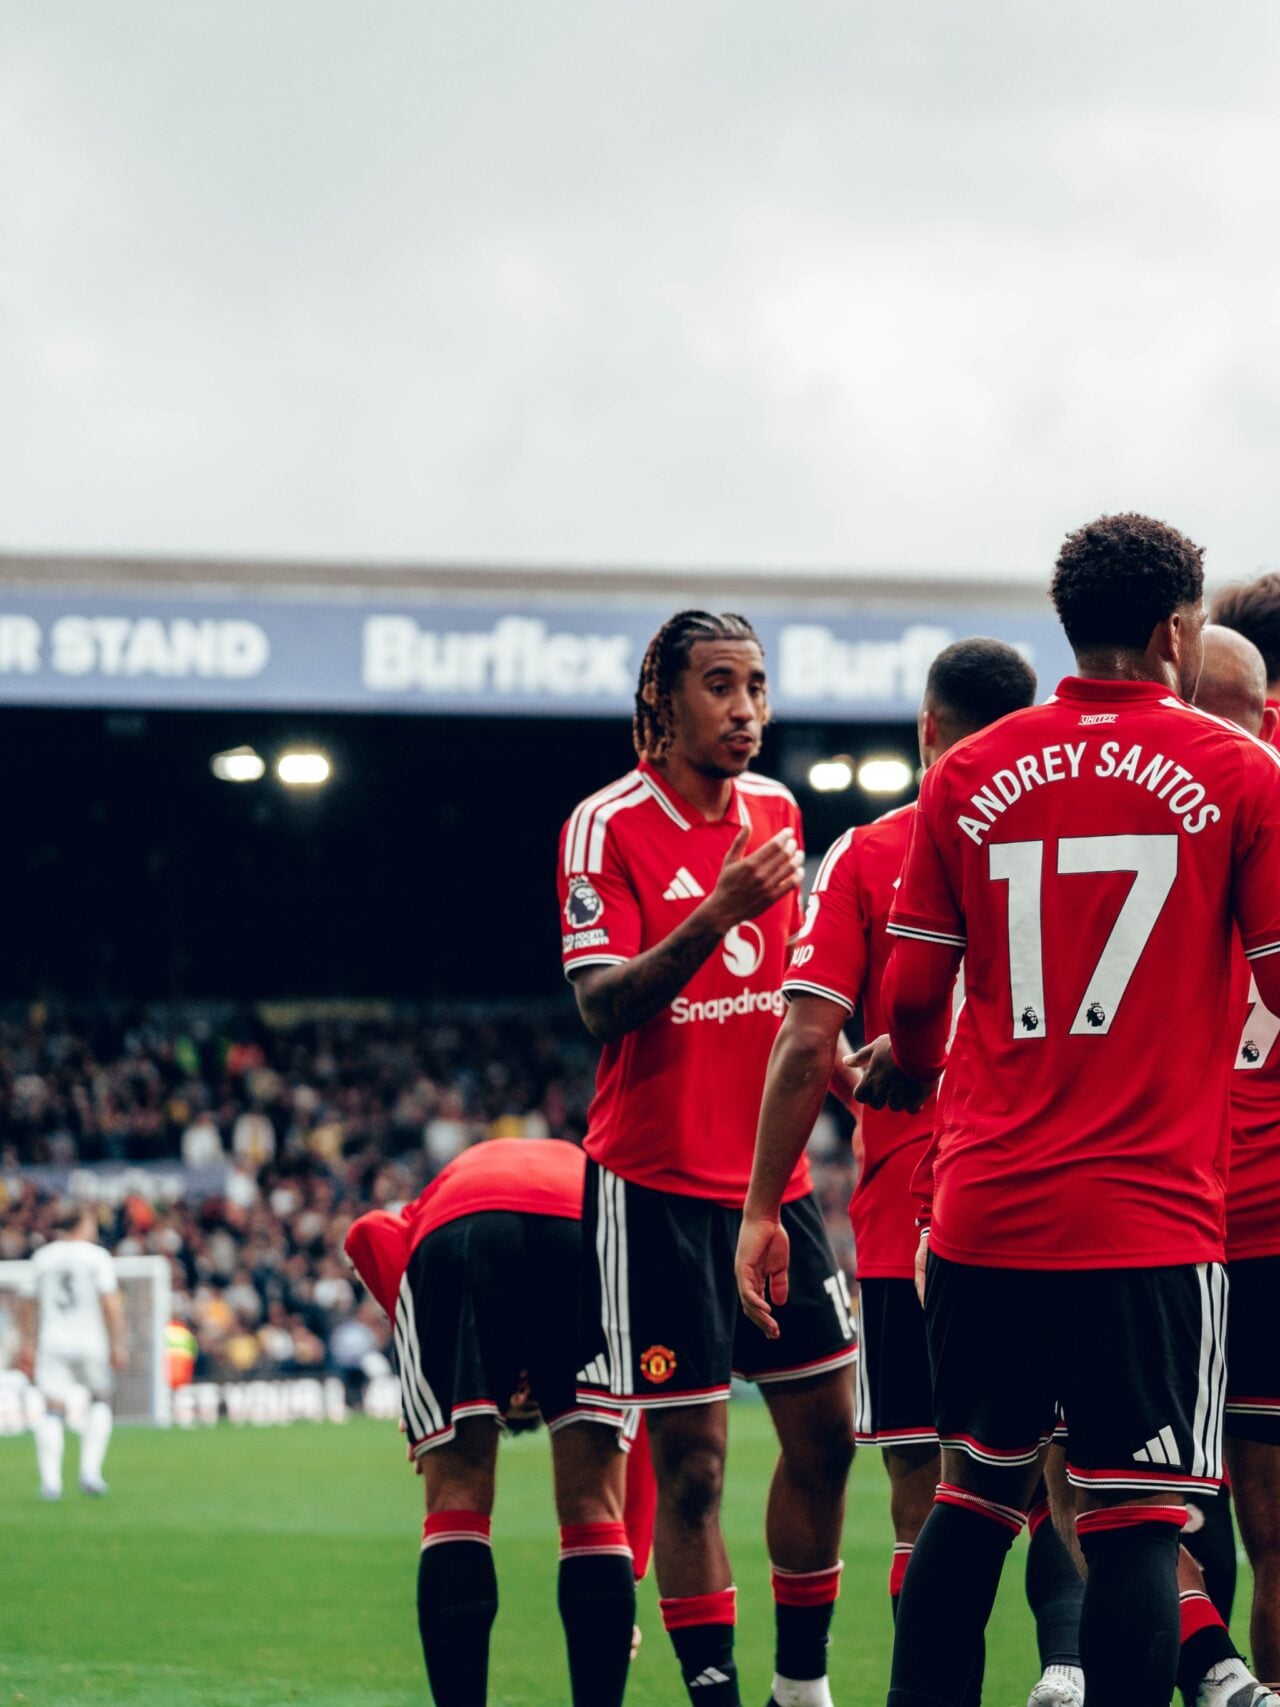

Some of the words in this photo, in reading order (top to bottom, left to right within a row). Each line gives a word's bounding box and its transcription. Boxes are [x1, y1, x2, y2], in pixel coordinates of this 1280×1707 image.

[50, 615, 269, 678] STAND
[362, 615, 632, 695] Burflex
[957, 742, 1087, 845] ANDREY
[1095, 741, 1221, 833] SANTOS
[988, 833, 1179, 1039] 17
[671, 986, 785, 1025] Snapdrag
